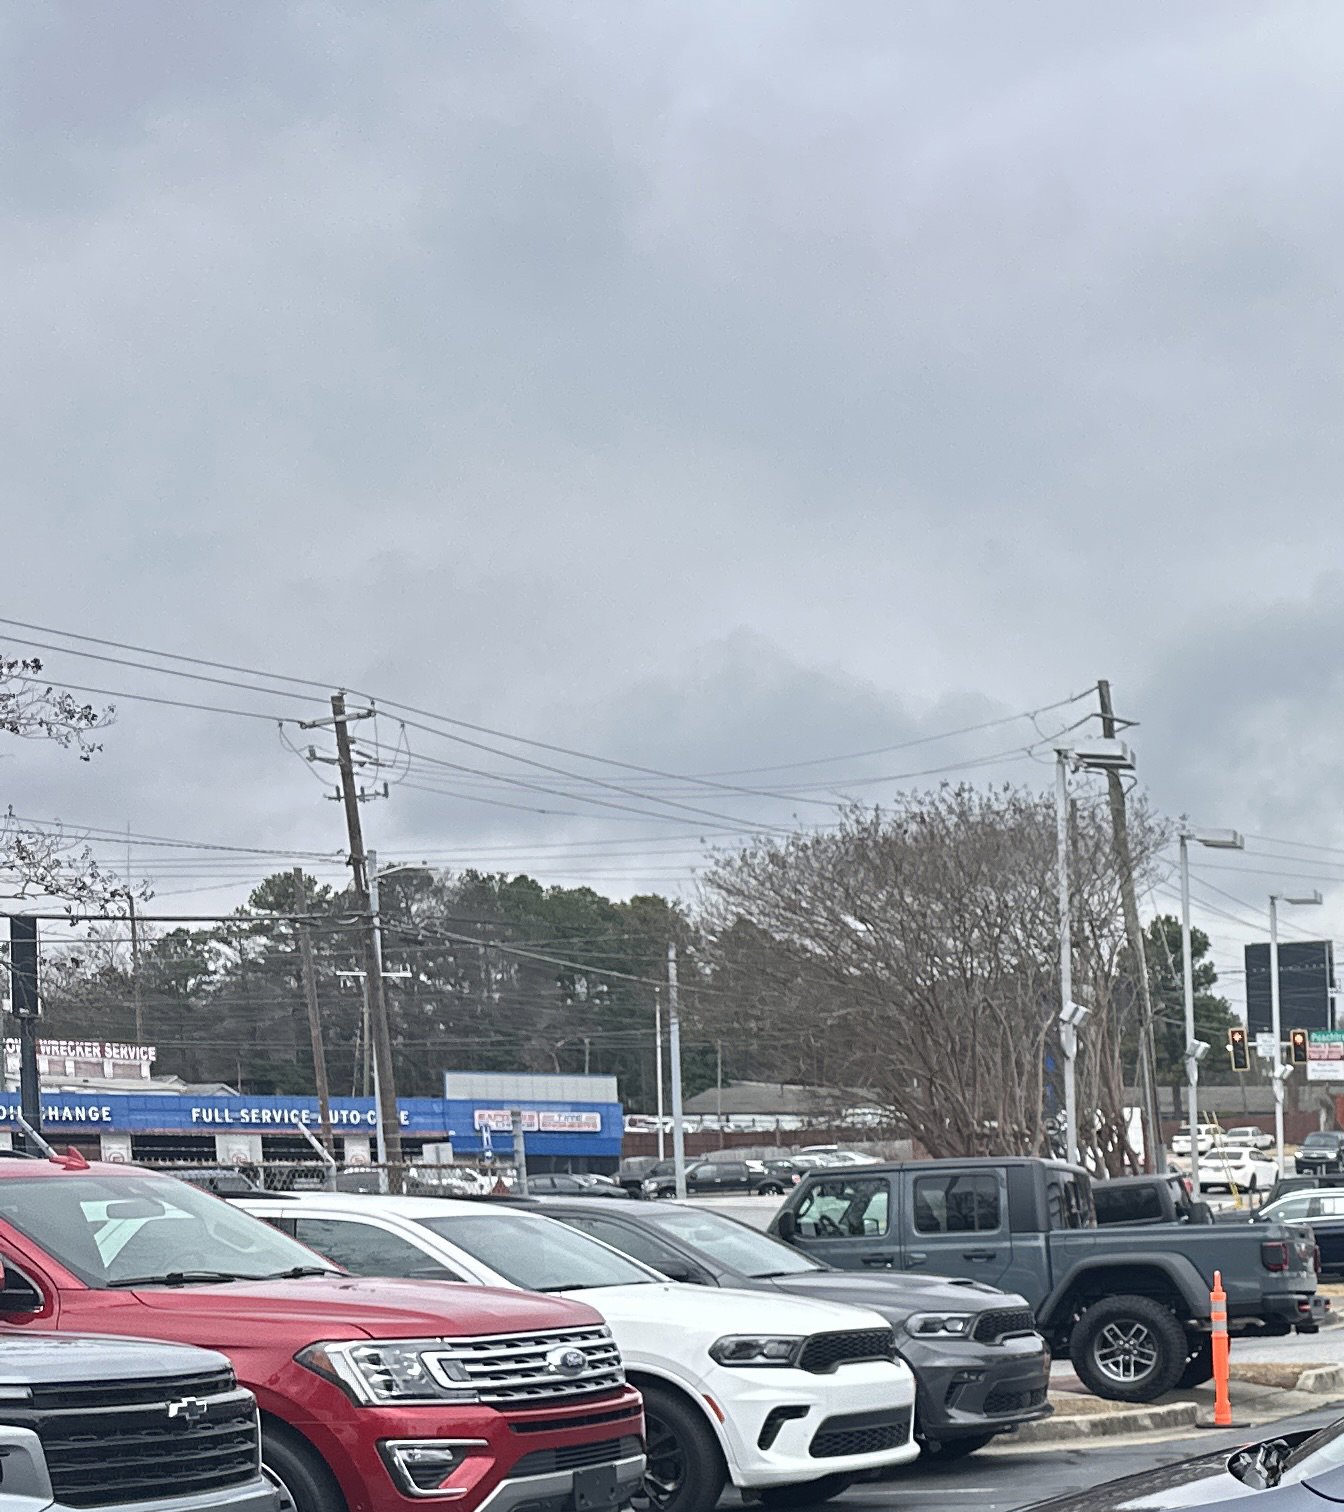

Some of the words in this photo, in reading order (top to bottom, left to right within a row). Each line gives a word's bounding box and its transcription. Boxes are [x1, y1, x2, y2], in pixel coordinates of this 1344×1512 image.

[39, 1039, 101, 1057] WRECKER
[104, 1042, 157, 1061] SERVICE
[41, 1106, 111, 1121] HANGE
[191, 1107, 234, 1123] FULL
[240, 1108, 311, 1124] SERVICE
[317, 1109, 361, 1125] UTO
[367, 1110, 410, 1126] CE
